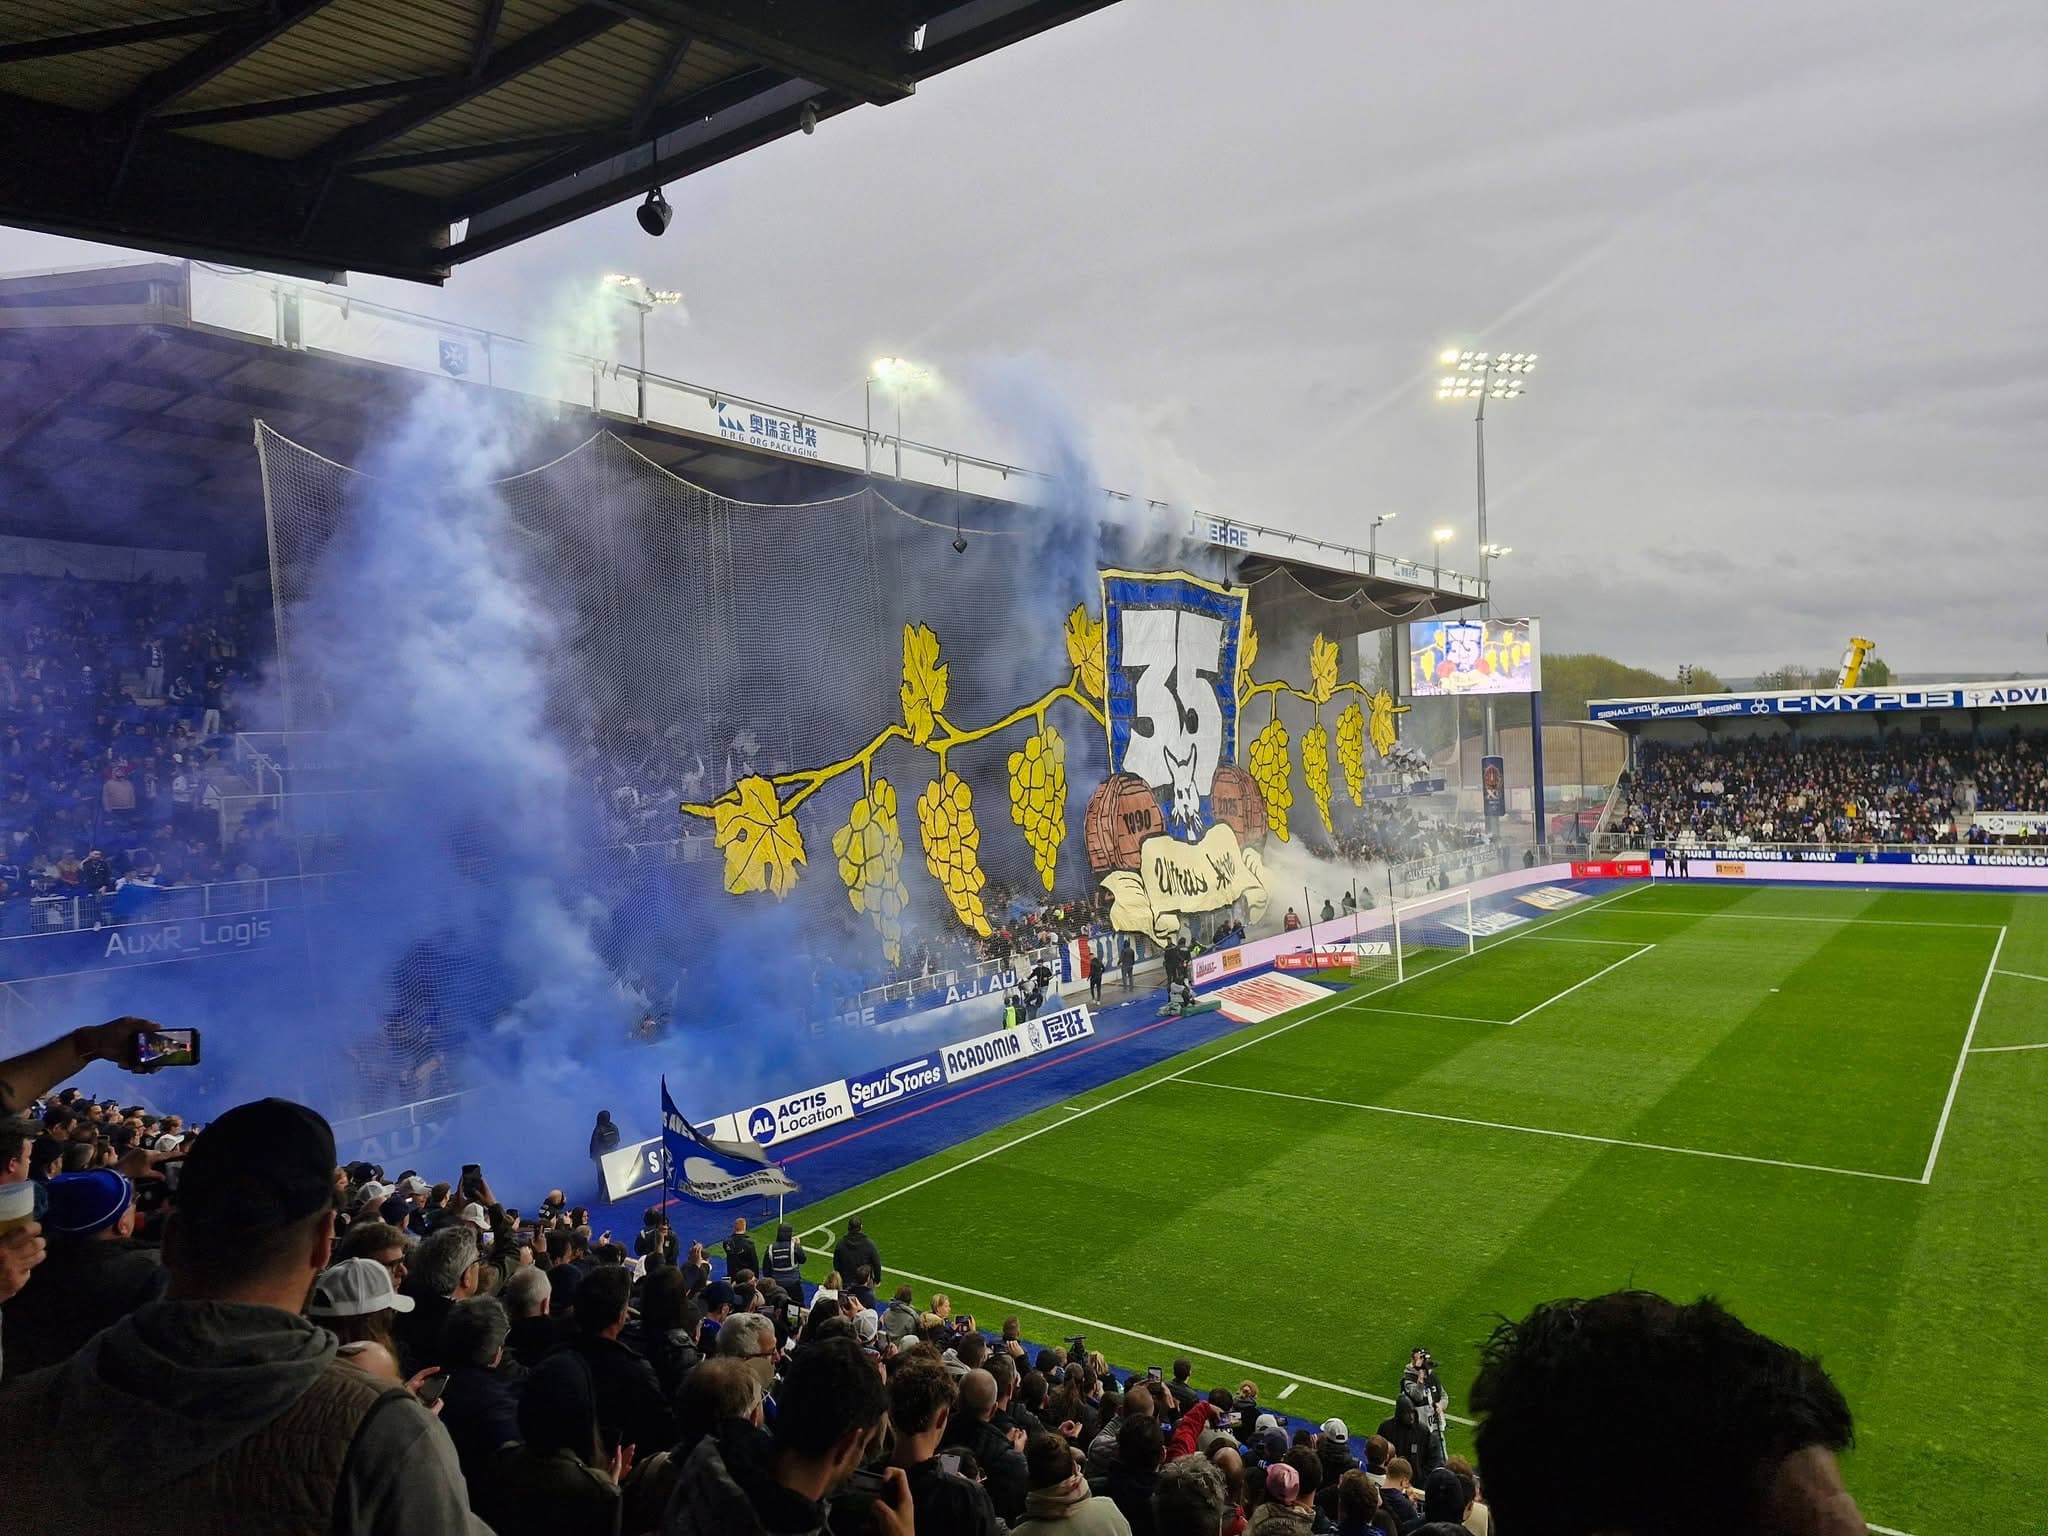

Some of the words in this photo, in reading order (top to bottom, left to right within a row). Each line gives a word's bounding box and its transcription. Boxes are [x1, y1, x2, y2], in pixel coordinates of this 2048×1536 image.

[750, 436, 768, 448] ORG
[770, 441, 818, 458] PACKAGING
[1209, 522, 1248, 547] ERRE
[1651, 702, 1703, 717] MARQUAGE
[1123, 808, 1152, 834] 1990
[1716, 850, 1783, 860] REMORQUES
[1786, 851, 1837, 861] LUAULT
[1911, 853, 1970, 864] LOUAULT
[1973, 855, 2048, 866] TECHNOLO
[947, 1033, 1020, 1075] ACADOMIA
[851, 1059, 941, 1108] ServiStores
[778, 1092, 827, 1120] ACTIS
[780, 1104, 843, 1133] Location
[752, 1117, 774, 1137] AL
